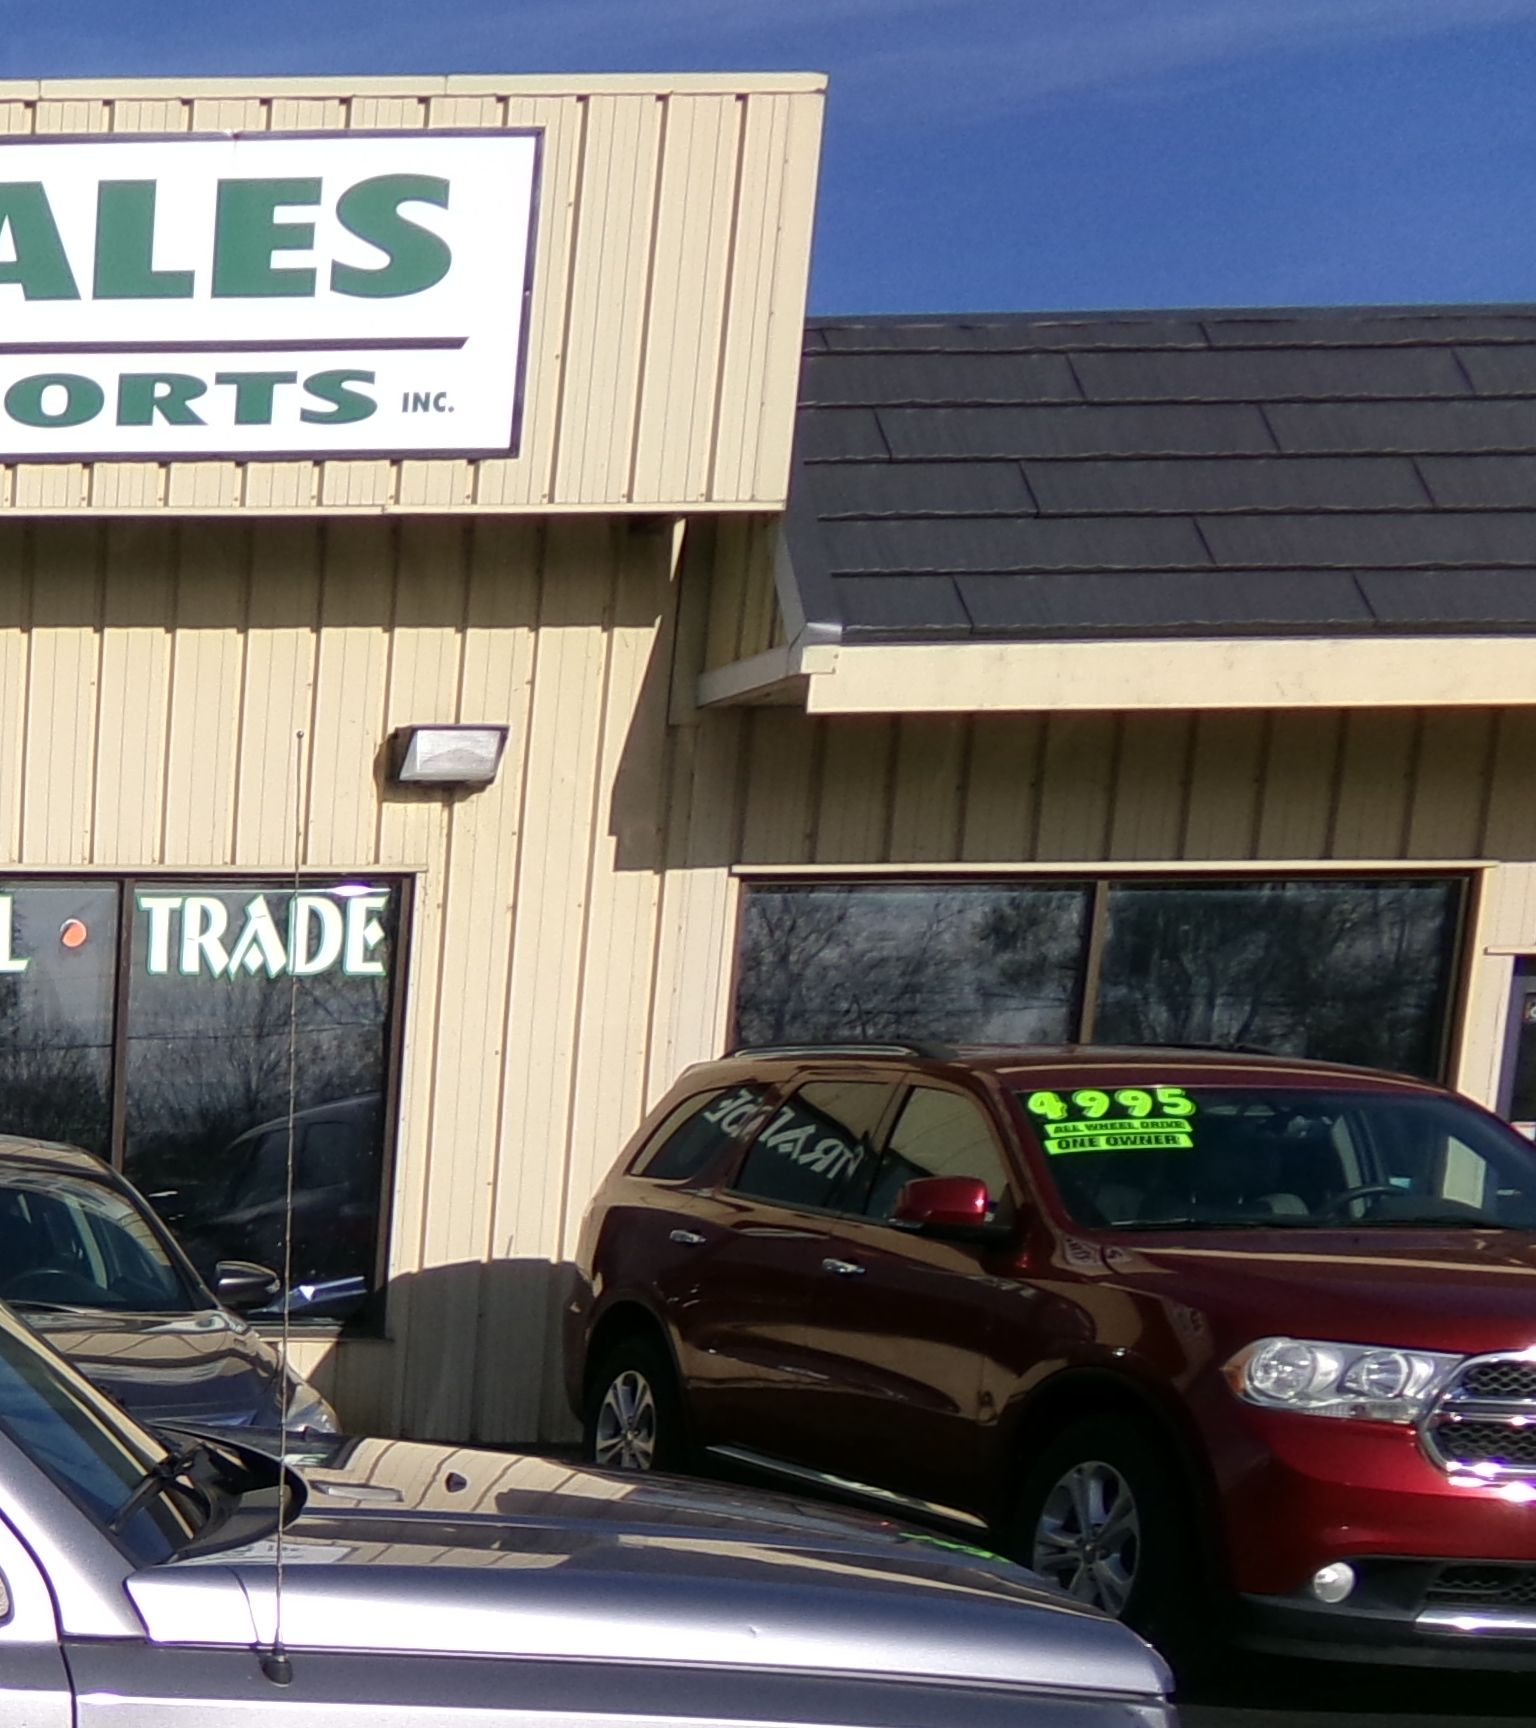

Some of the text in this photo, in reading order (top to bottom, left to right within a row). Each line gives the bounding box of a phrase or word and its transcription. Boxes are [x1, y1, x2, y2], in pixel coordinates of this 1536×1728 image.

[401, 391, 455, 413] INC.
[136, 895, 392, 978] TRADE
[1028, 1087, 1196, 1120] 4995
[1053, 1120, 1186, 1134] ALL WHEEL DRIVE
[1057, 1134, 1180, 1150] ONE OWNER
